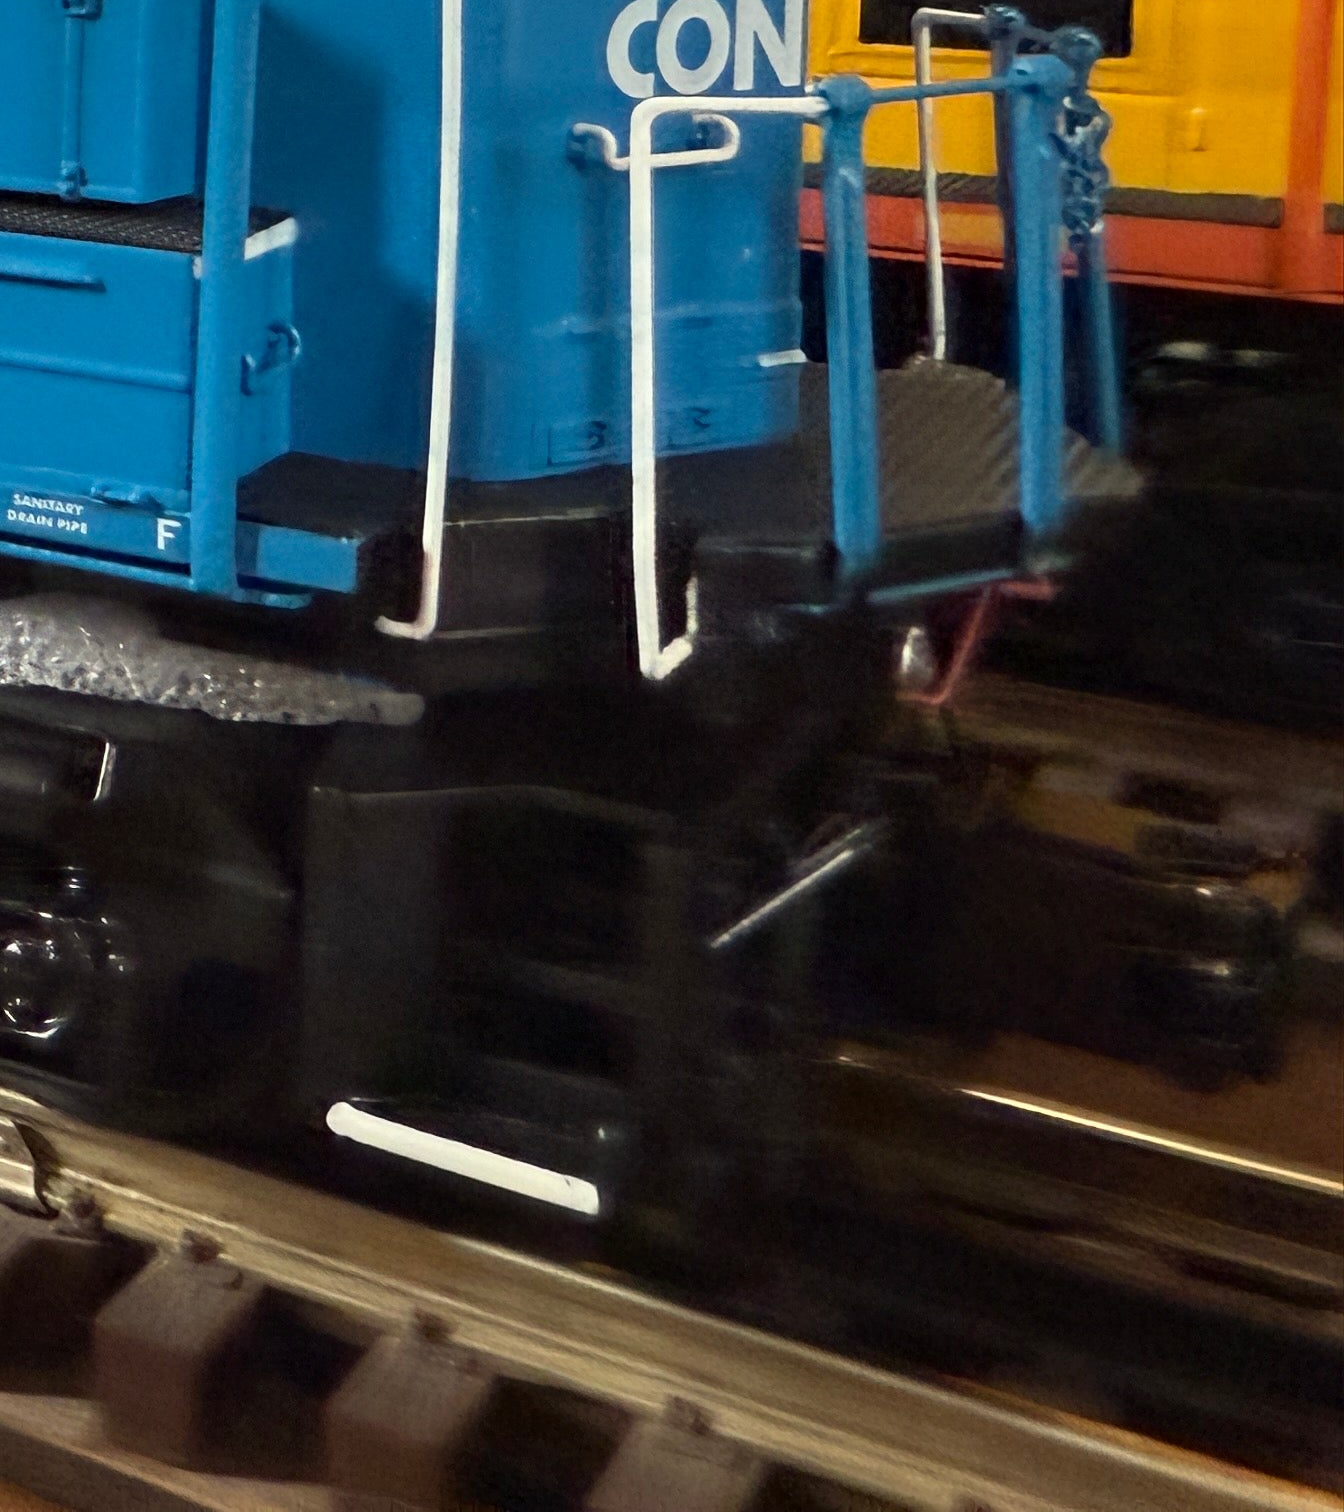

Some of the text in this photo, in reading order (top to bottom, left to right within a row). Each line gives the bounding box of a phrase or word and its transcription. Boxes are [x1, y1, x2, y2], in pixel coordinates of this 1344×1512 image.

[13, 493, 83, 515] SANITARY
[7, 509, 87, 534] DRAIN PIPE
[157, 517, 182, 550] F
